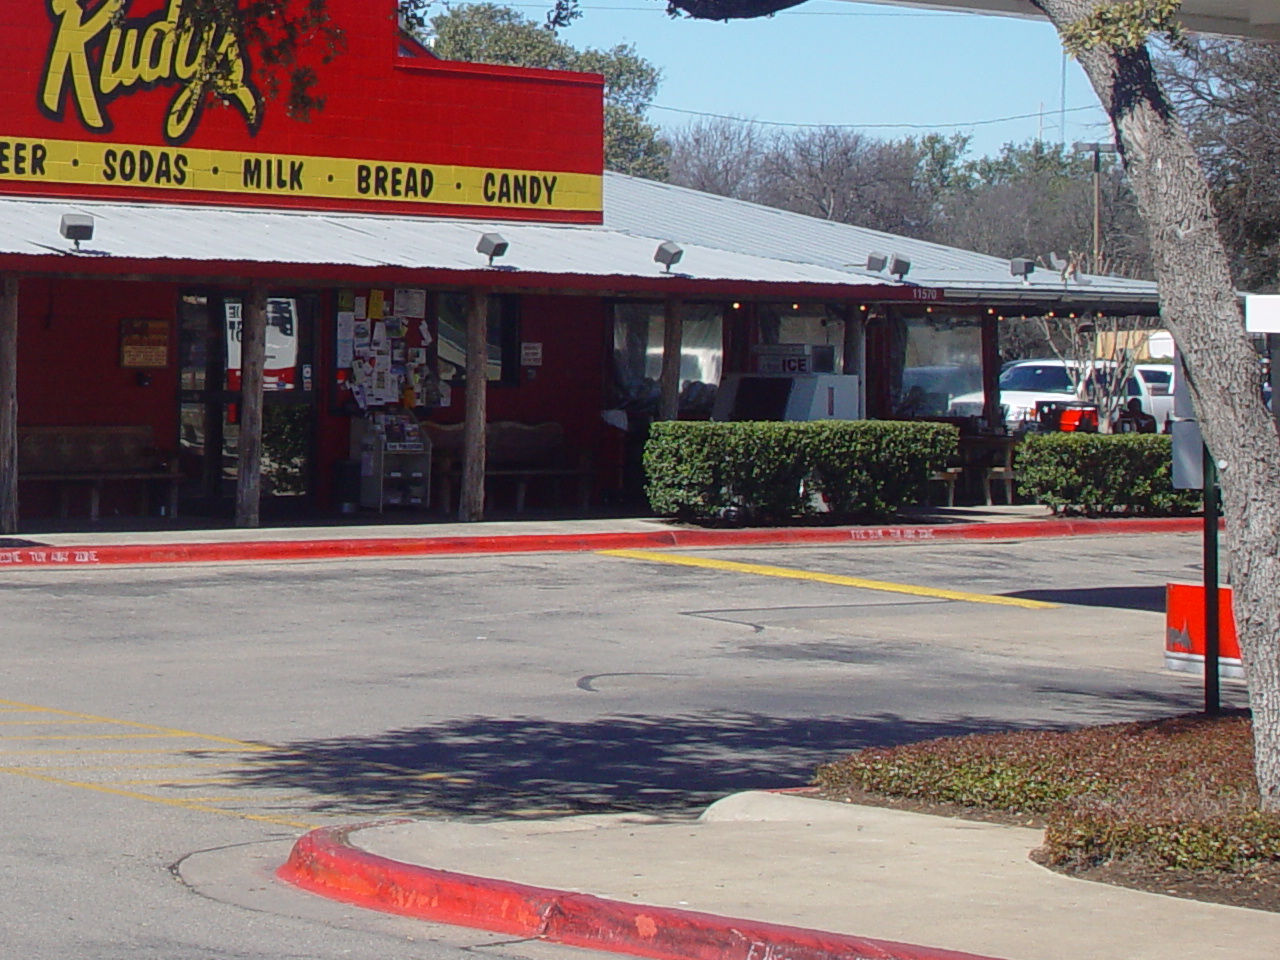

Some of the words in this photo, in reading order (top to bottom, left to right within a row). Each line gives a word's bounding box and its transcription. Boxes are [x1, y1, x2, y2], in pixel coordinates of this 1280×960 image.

[102, 148, 188, 186] SODAS
[242, 158, 304, 191] MILK
[356, 164, 434, 199] BREAD
[482, 171, 557, 206] CANDY
[912, 288, 937, 300] 11570
[781, 358, 807, 372] ICE
